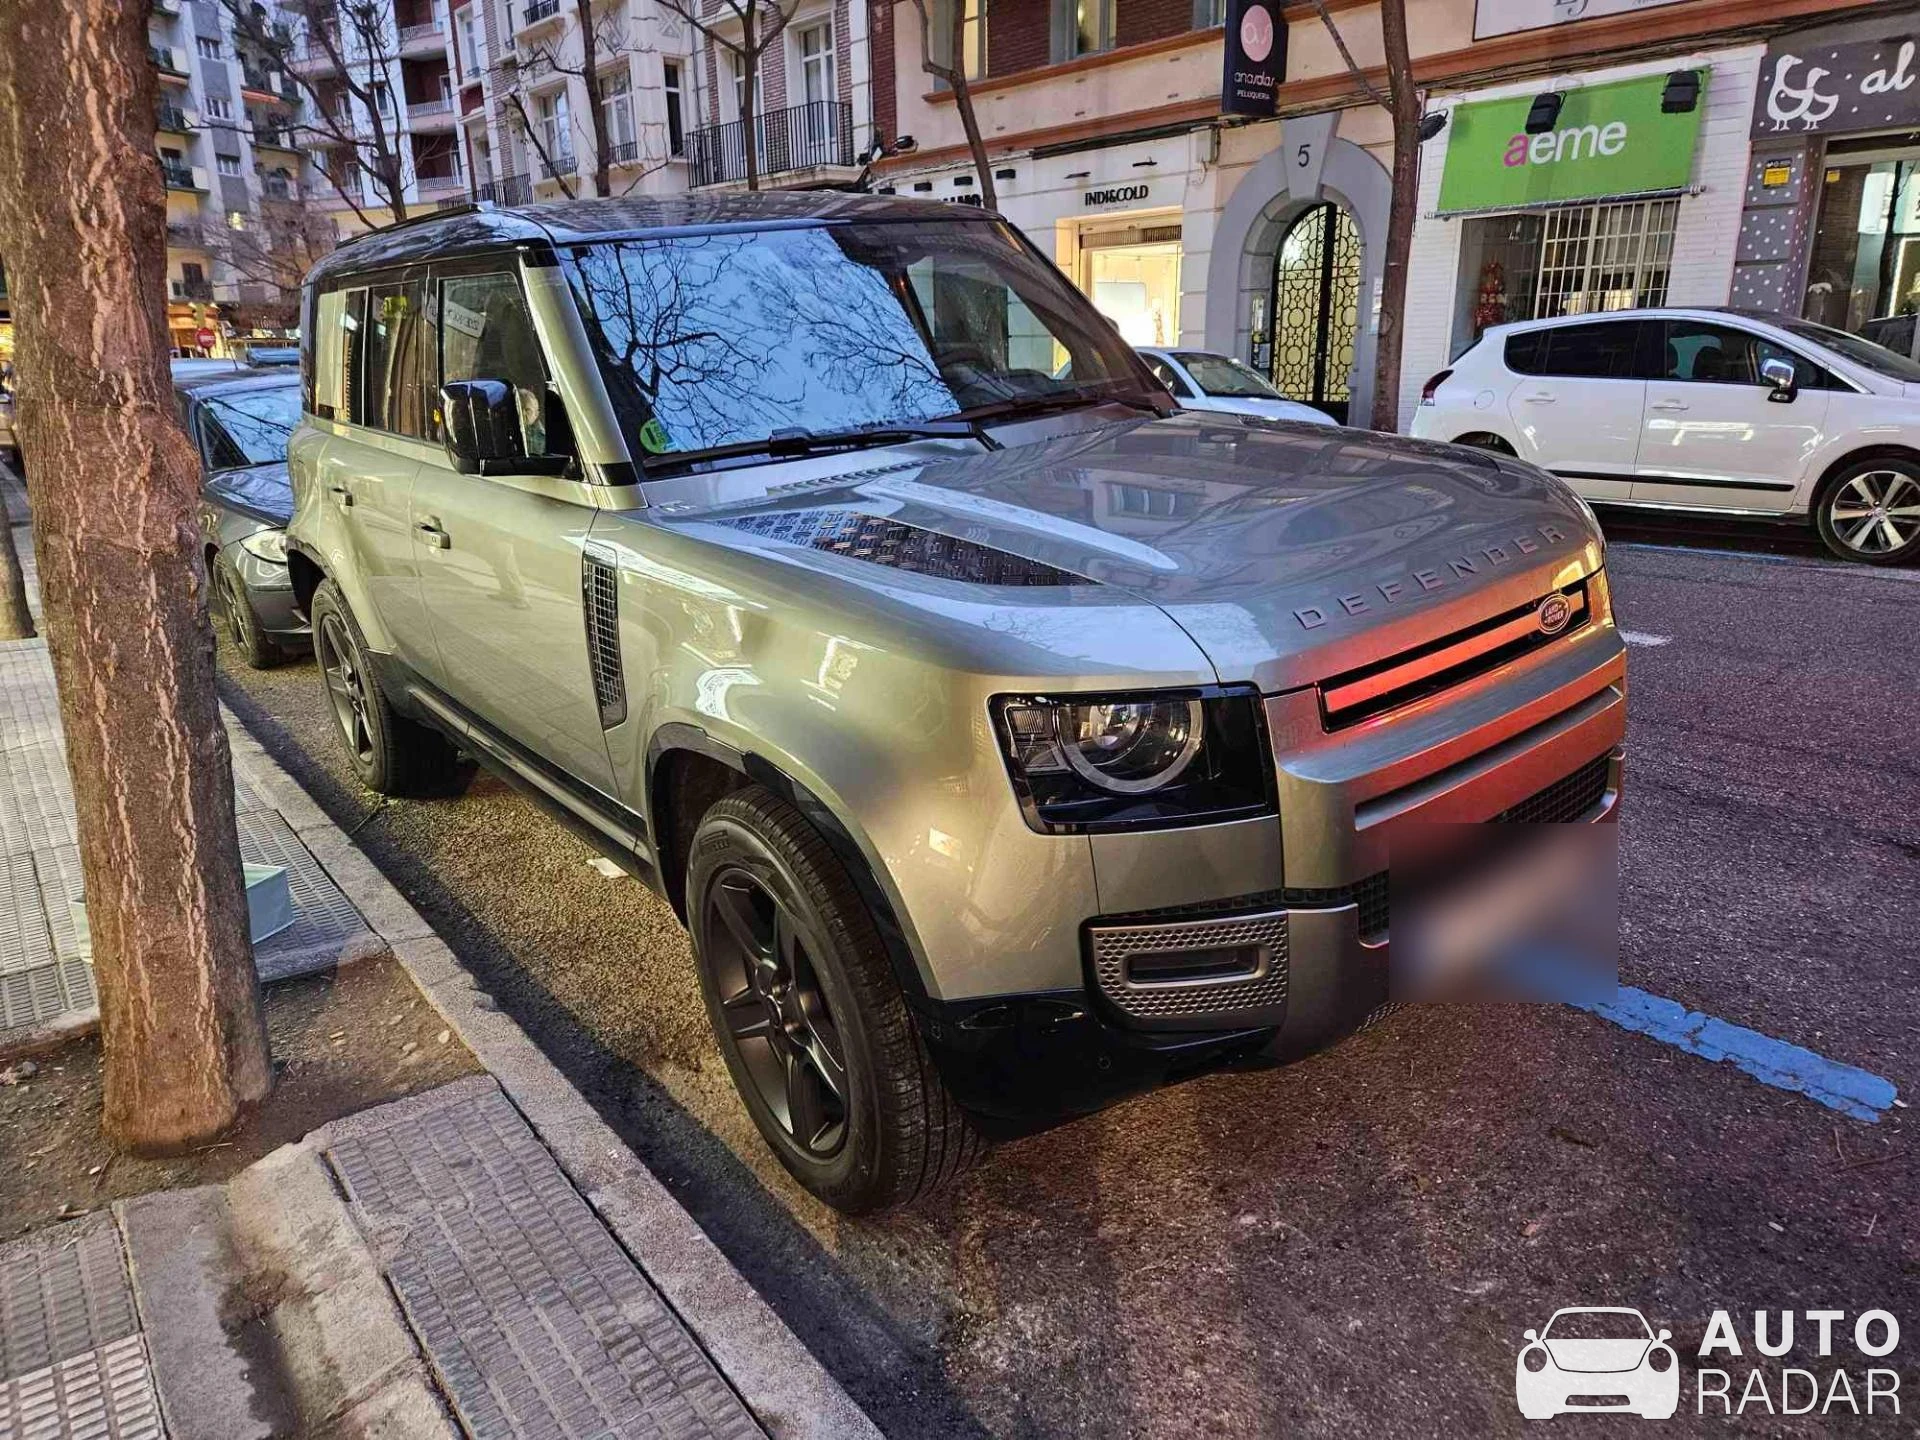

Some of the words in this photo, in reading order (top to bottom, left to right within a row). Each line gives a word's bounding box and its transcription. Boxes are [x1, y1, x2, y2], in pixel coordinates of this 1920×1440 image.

[1860, 41, 1916, 94] al
[1298, 144, 1311, 168] 5
[1503, 121, 1627, 167] aeme
[1085, 185, 1149, 206] INDI&COLD
[1292, 524, 1566, 631] DEFENDER
